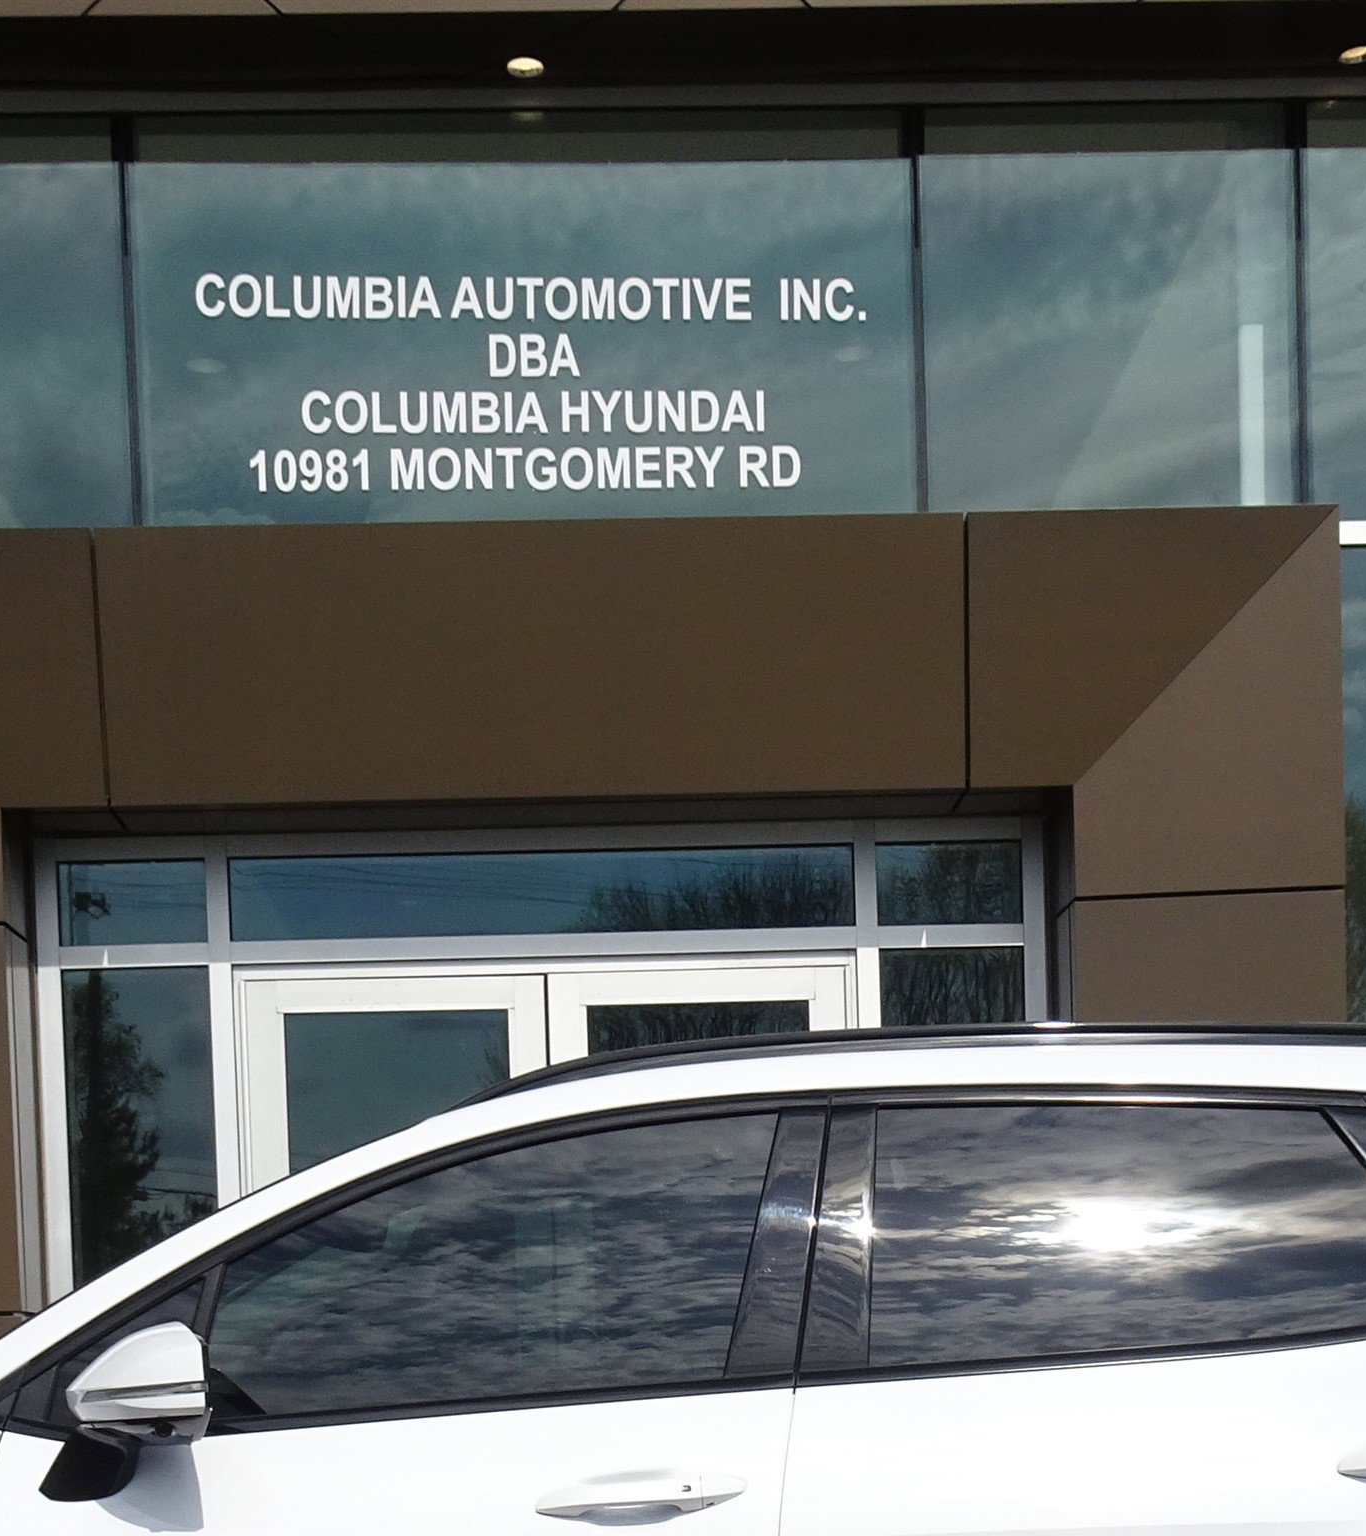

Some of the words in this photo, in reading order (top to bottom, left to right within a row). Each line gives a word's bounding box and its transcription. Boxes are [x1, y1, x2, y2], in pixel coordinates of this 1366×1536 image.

[194, 272, 442, 320] COLUMBIA
[449, 275, 753, 322] AUTOMOTIVE
[779, 277, 868, 323] INC.
[487, 332, 582, 379] DBA
[300, 389, 549, 435] COLUMBIA
[559, 388, 766, 434] HYUNDAI
[248, 447, 371, 494] 10981
[389, 445, 726, 492] MONTGOMERY
[738, 444, 802, 489] RD
